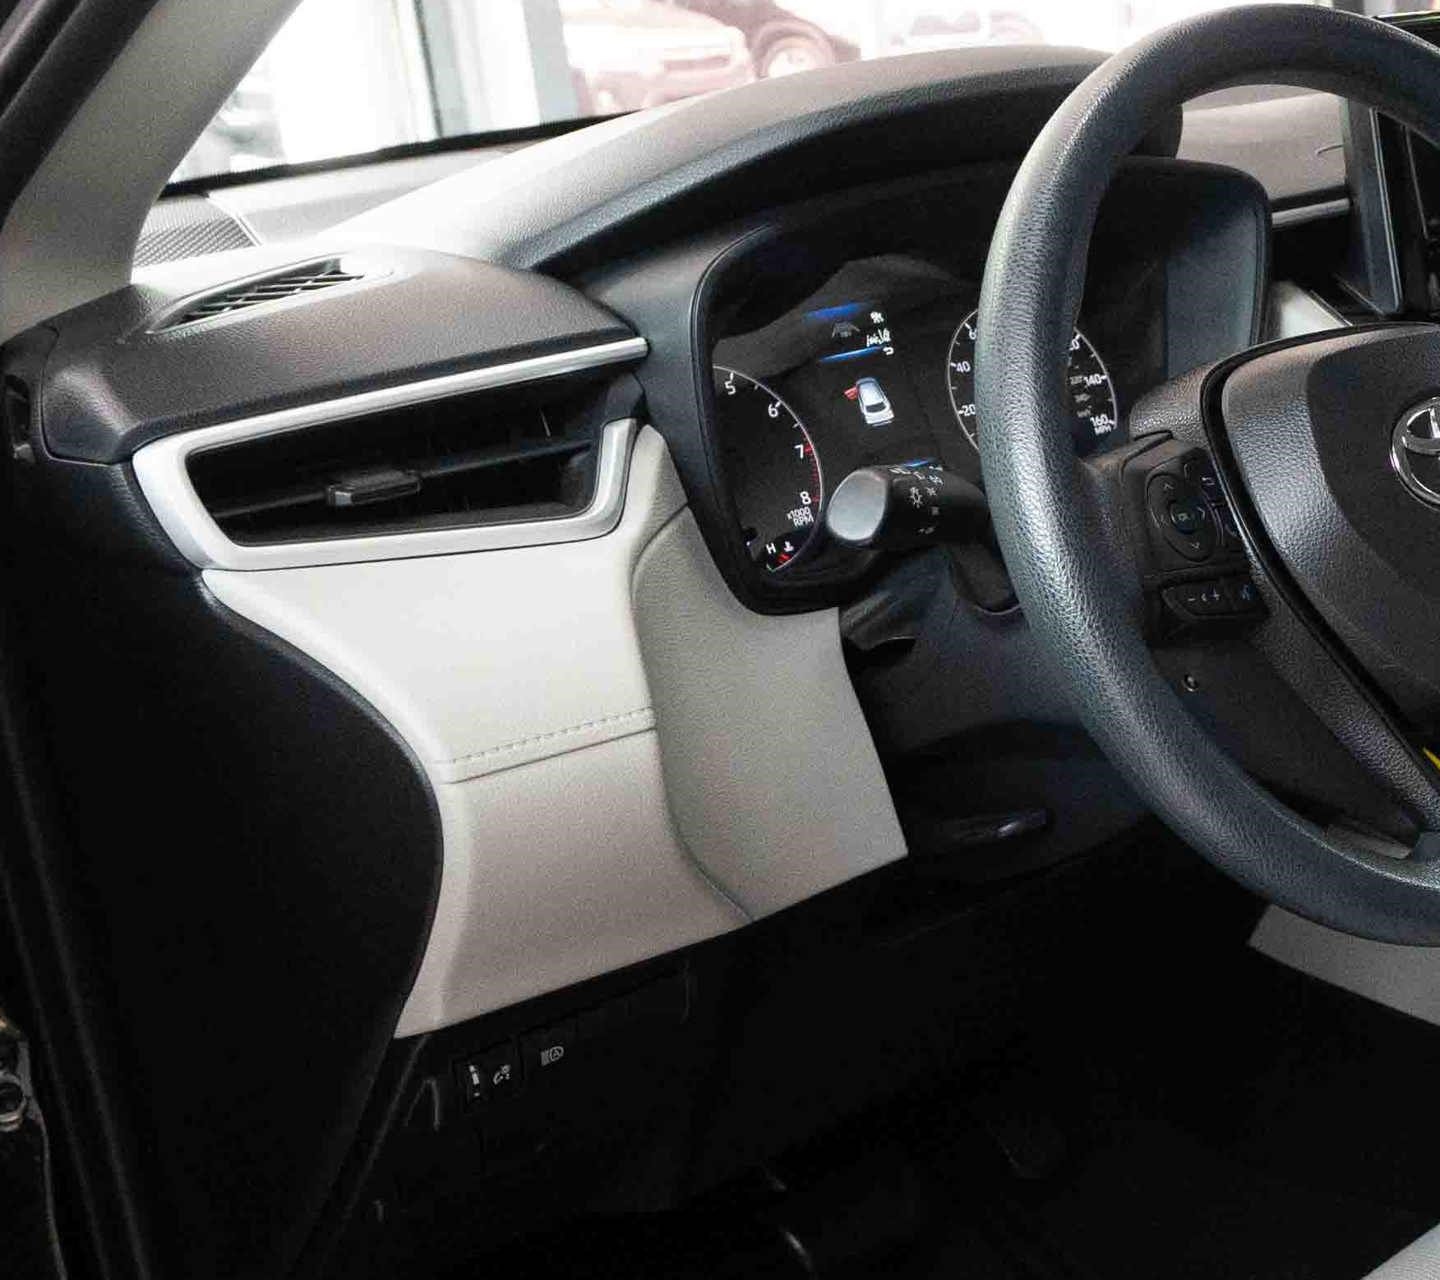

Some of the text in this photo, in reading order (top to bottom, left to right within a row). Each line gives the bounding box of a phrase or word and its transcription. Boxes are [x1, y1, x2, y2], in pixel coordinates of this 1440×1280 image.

[956, 360, 971, 373] 40
[724, 381, 736, 395] 5
[767, 404, 778, 417] 6
[794, 444, 804, 458] 7
[800, 491, 811, 505] 8
[766, 542, 776, 554] H
